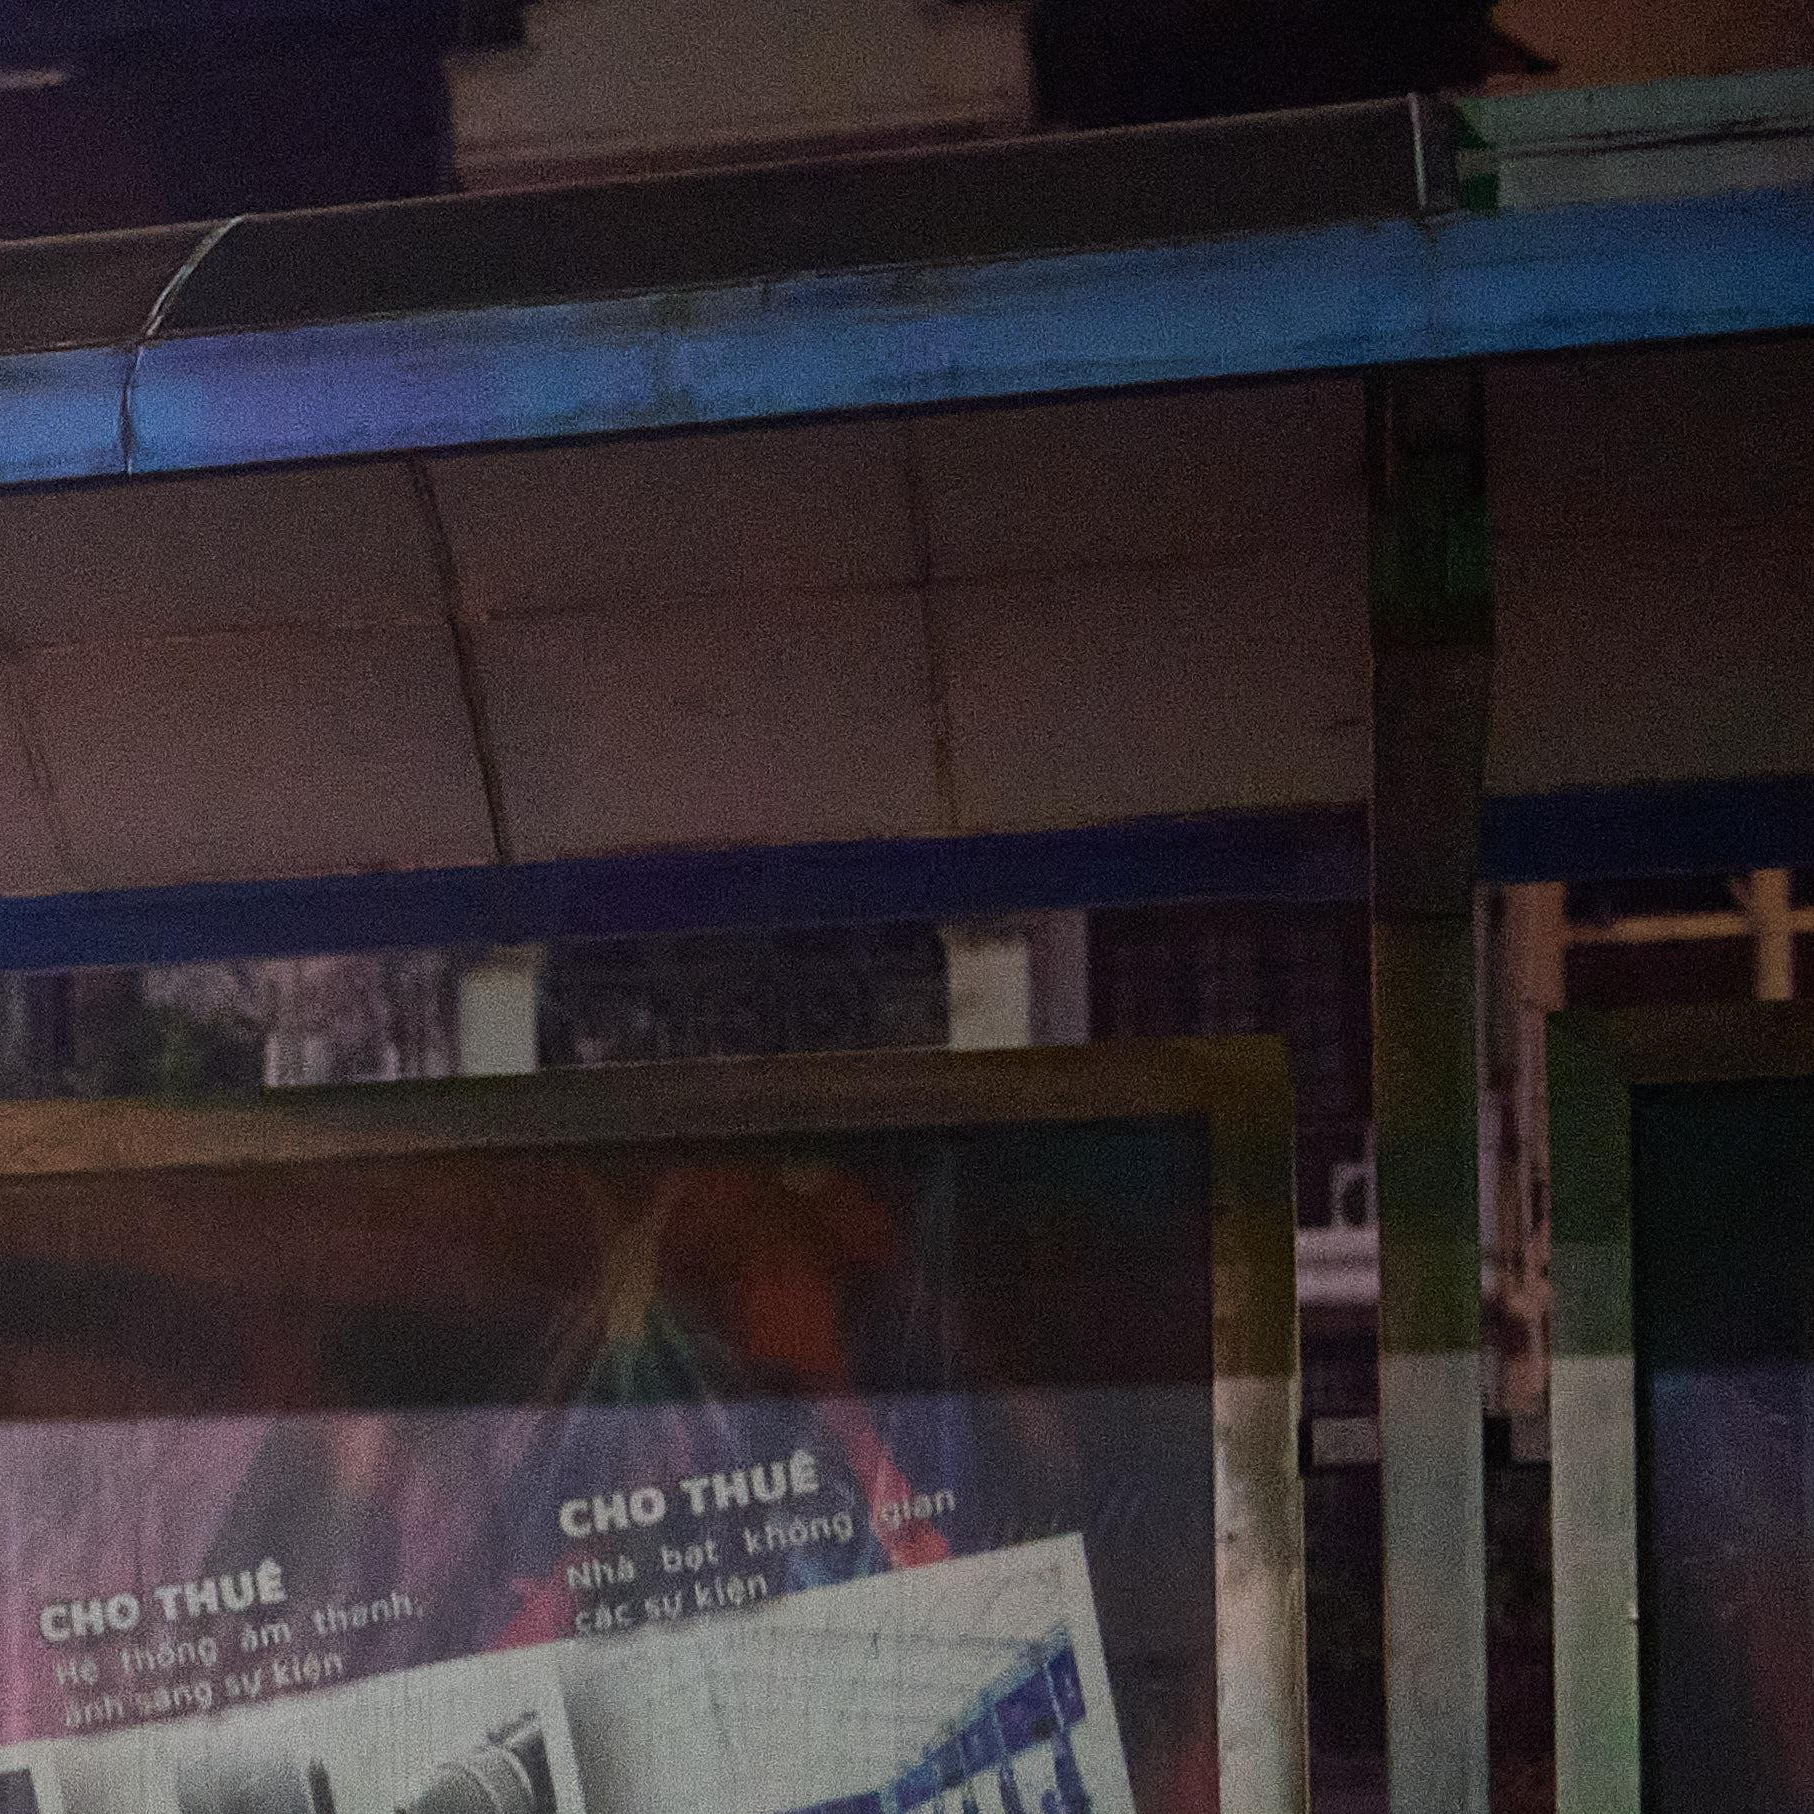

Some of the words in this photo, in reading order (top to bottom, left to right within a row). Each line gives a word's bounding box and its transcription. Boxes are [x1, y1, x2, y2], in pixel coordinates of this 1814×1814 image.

[559, 1487, 667, 1537] CHO
[680, 1449, 820, 1516] THUÊ
[745, 1511, 853, 1555] không
[880, 1487, 956, 1529] gian
[40, 1593, 140, 1641] CHO
[155, 1557, 287, 1622] THUÊ
[575, 1602, 636, 1632] các
